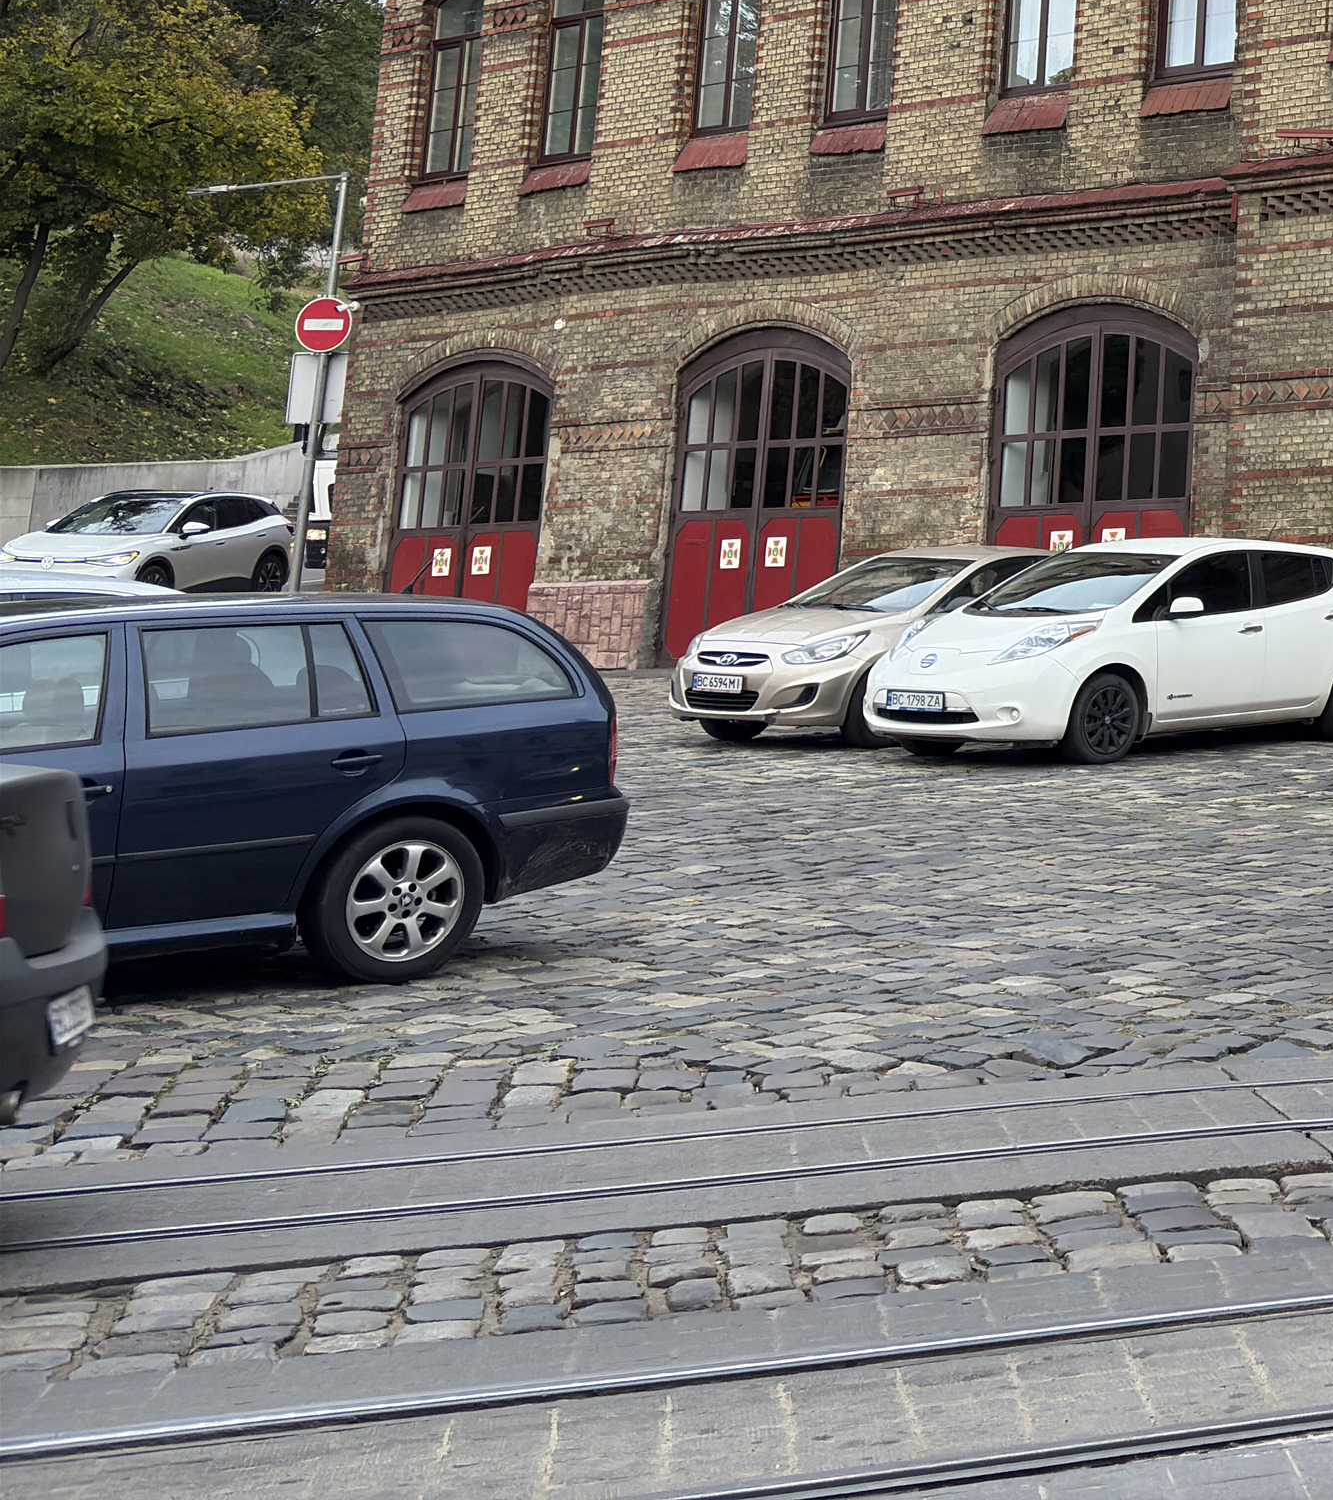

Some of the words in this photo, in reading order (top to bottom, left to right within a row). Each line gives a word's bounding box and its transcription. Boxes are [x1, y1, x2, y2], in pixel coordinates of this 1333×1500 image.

[892, 693, 904, 705] BC
[906, 694, 926, 707] 1798
[927, 695, 940, 707] ZA
